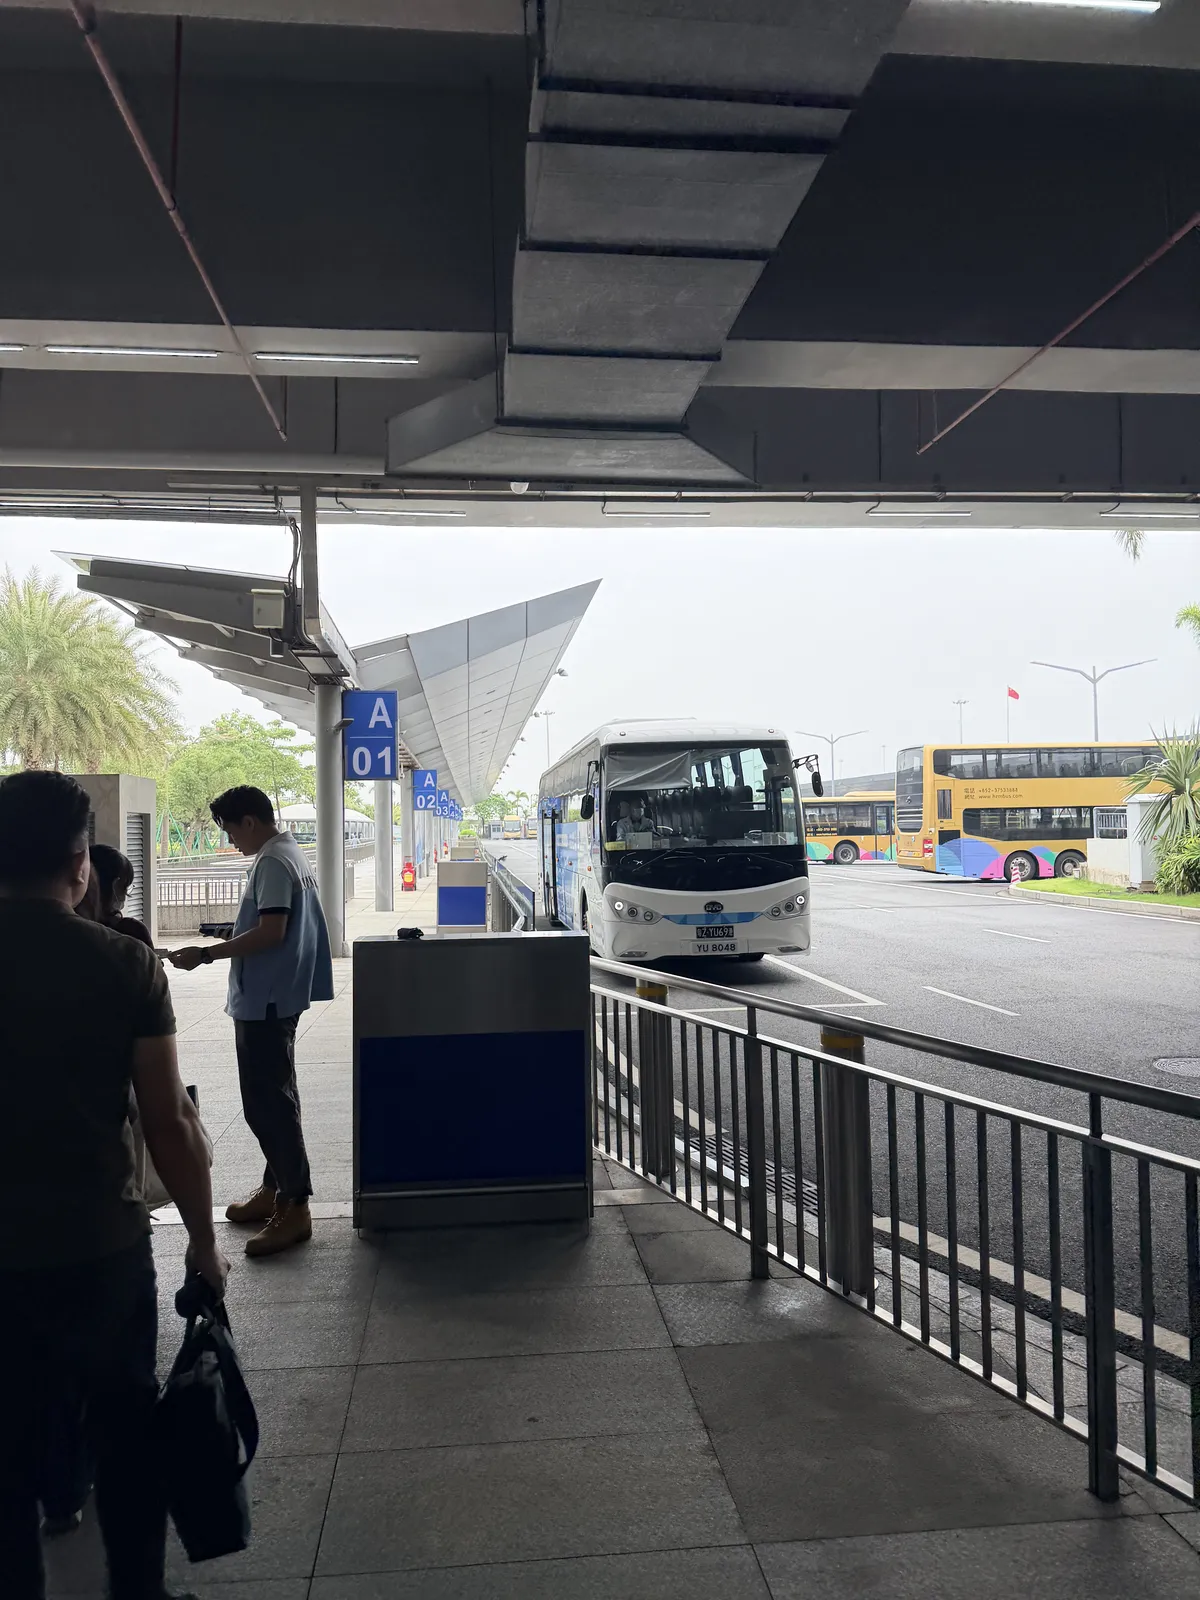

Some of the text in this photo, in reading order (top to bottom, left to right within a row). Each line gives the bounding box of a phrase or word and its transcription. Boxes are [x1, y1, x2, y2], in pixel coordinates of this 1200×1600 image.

[368, 697, 393, 728] A
[352, 746, 391, 775] 01
[424, 772, 435, 787] A
[417, 795, 436, 809] 02
[440, 791, 448, 802] A
[436, 806, 448, 816] 03
[697, 943, 735, 952] YU 8048
